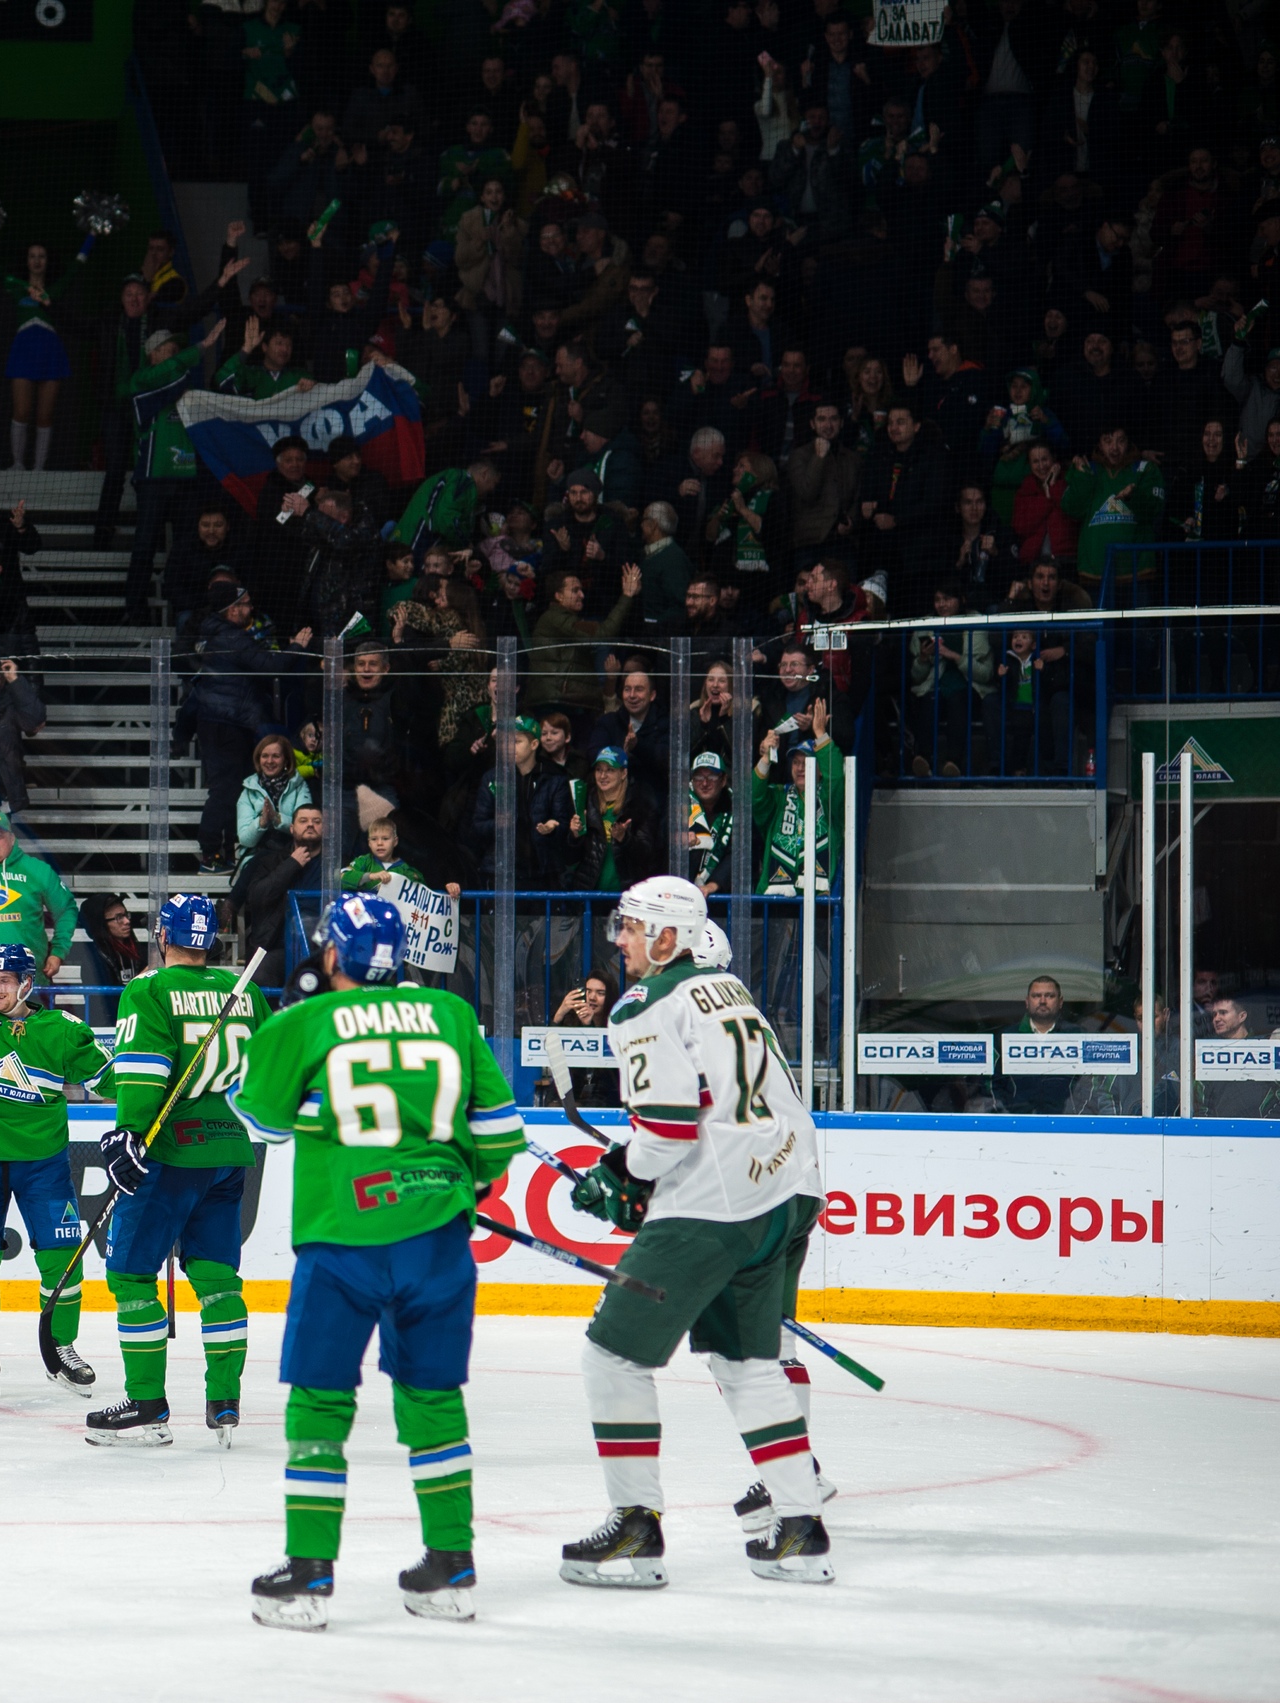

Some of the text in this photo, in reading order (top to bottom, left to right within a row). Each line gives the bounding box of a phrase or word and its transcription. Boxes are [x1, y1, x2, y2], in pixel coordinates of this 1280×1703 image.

[1195, 772, 1222, 780] ЮЛАЕВ
[397, 879, 452, 916] КАПИТАН
[191, 933, 205, 946] 70
[365, 968, 389, 981] 67
[333, 1001, 439, 1039] OMARK
[115, 1013, 138, 1050] 70
[864, 1044, 984, 1059] СОГАЗ СТРАХОВАЯ
[948, 1052, 977, 1060] ГРУППА
[1008, 1045, 1079, 1059] СОГАЗ
[1092, 1052, 1121, 1060] ГРУППА
[1201, 1051, 1271, 1065] СОГАЗ
[182, 1021, 251, 1099] 70
[9, 1089, 36, 1100] ЮЛАЕВ
[327, 1041, 462, 1148] 67
[817, 1189, 1164, 1258] евизоры
[55, 1227, 83, 1239] ПЕГА
[531, 1240, 578, 1266] BAUER
